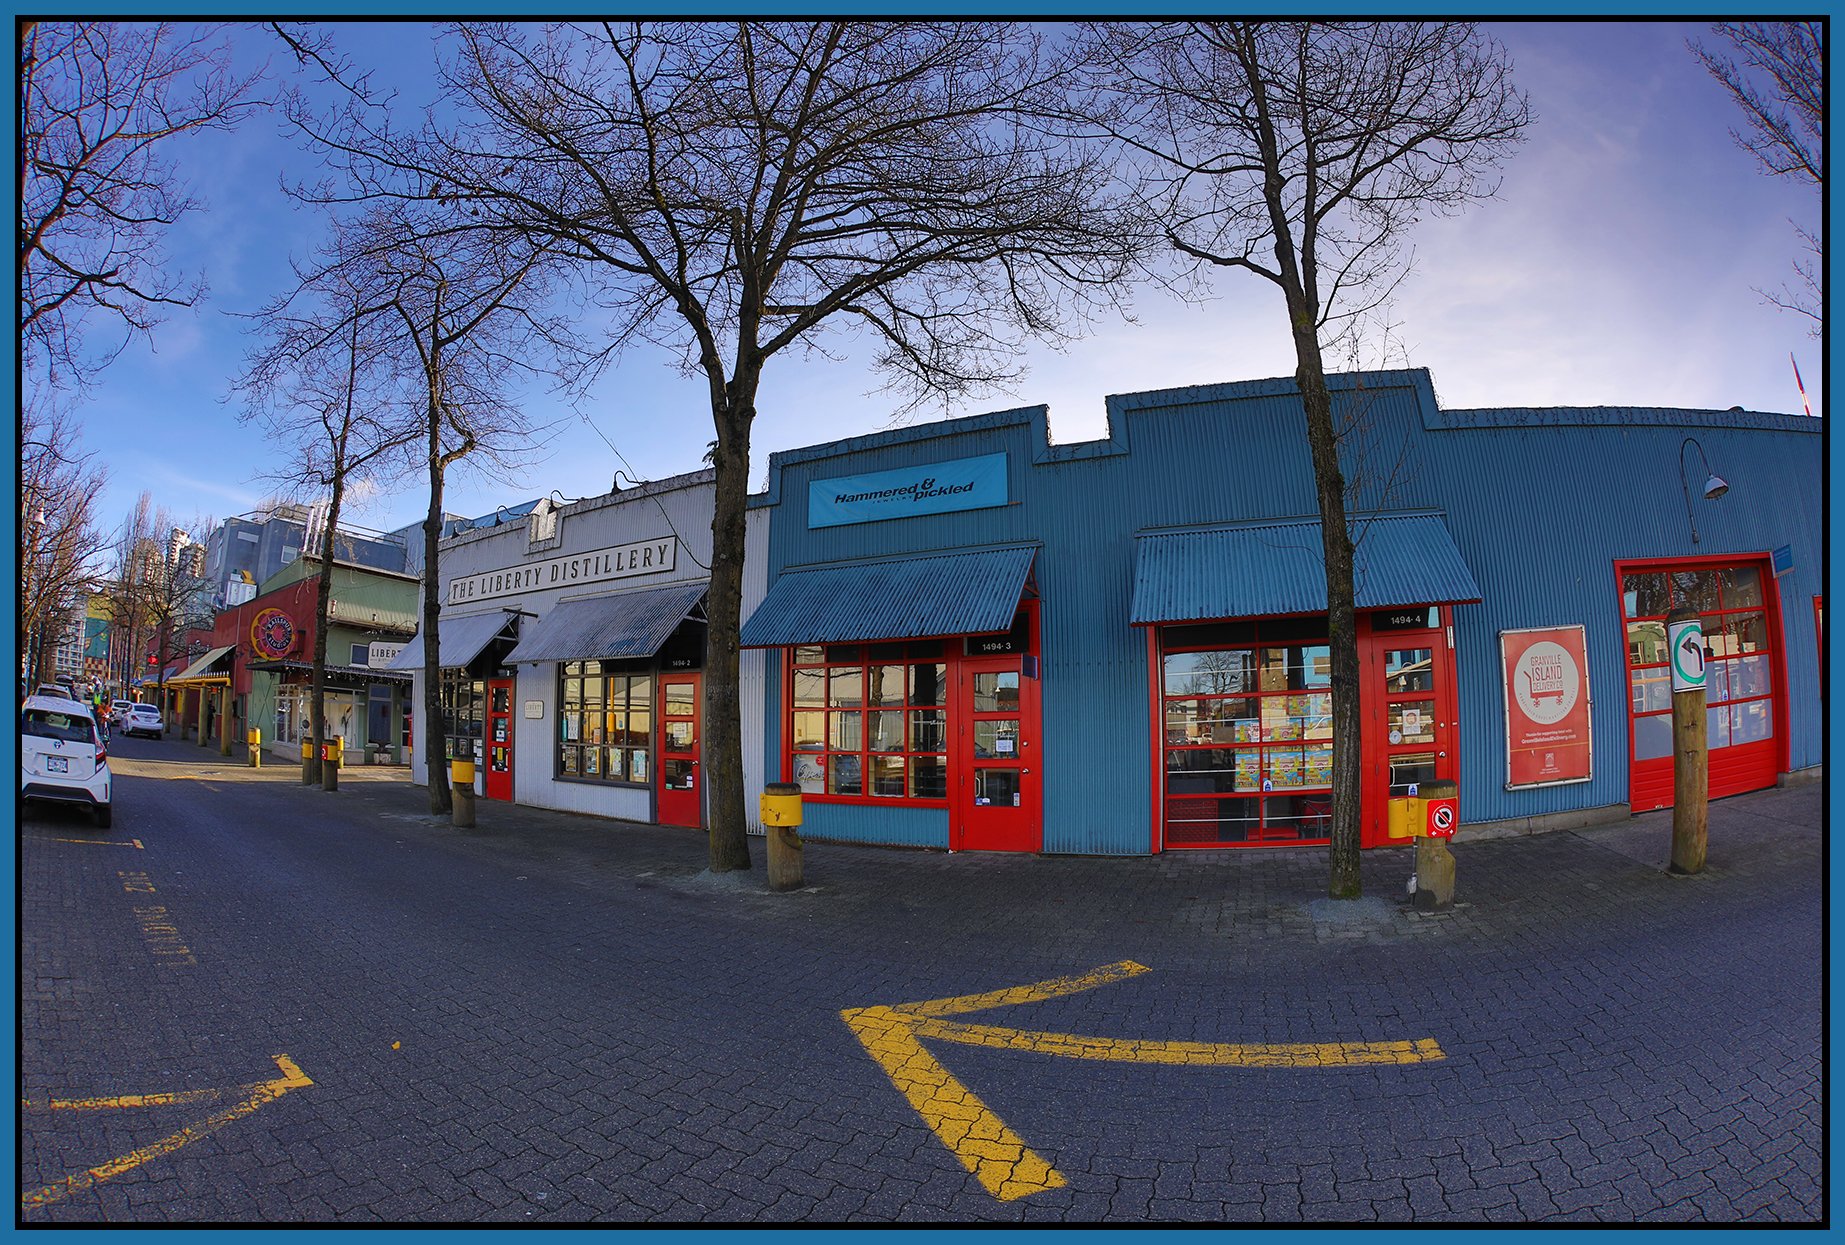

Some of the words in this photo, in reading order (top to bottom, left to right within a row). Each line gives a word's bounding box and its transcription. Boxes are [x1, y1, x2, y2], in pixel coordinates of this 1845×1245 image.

[913, 481, 974, 502] pickled
[921, 478, 936, 490] &
[834, 484, 918, 504] Hammered
[451, 580, 475, 600] THE
[480, 567, 543, 595] LIBERTY
[550, 544, 669, 583] DISTILLERY
[267, 617, 292, 632] RAILSPUR
[1530, 655, 1562, 667] GRANVILLE
[1531, 665, 1563, 681] ISLAND
